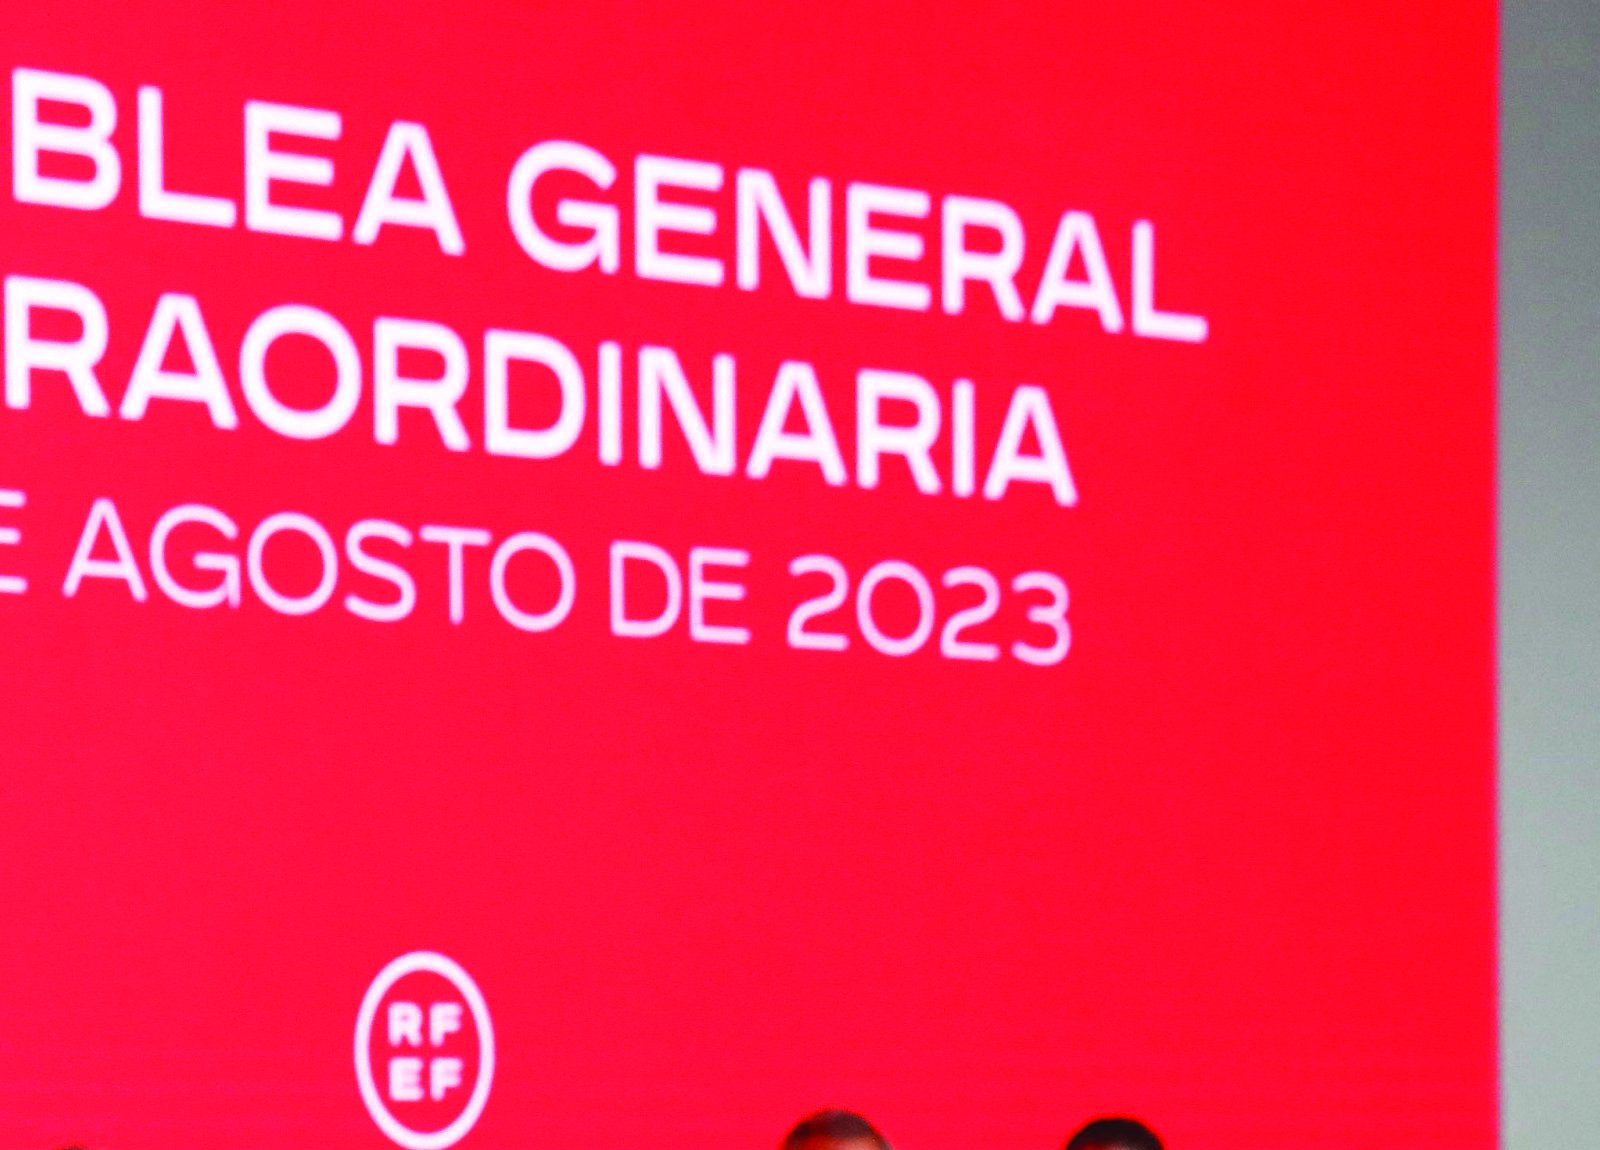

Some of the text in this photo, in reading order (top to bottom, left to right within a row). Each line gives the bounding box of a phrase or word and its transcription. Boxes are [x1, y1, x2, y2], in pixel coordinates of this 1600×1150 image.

[505, 138, 1210, 344] GENERAL
[61, 496, 578, 633] AGOSTO
[608, 540, 751, 645] DE
[786, 553, 1073, 667] 2023
[387, 1001, 462, 1047] RF
[388, 1056, 463, 1102] EF
